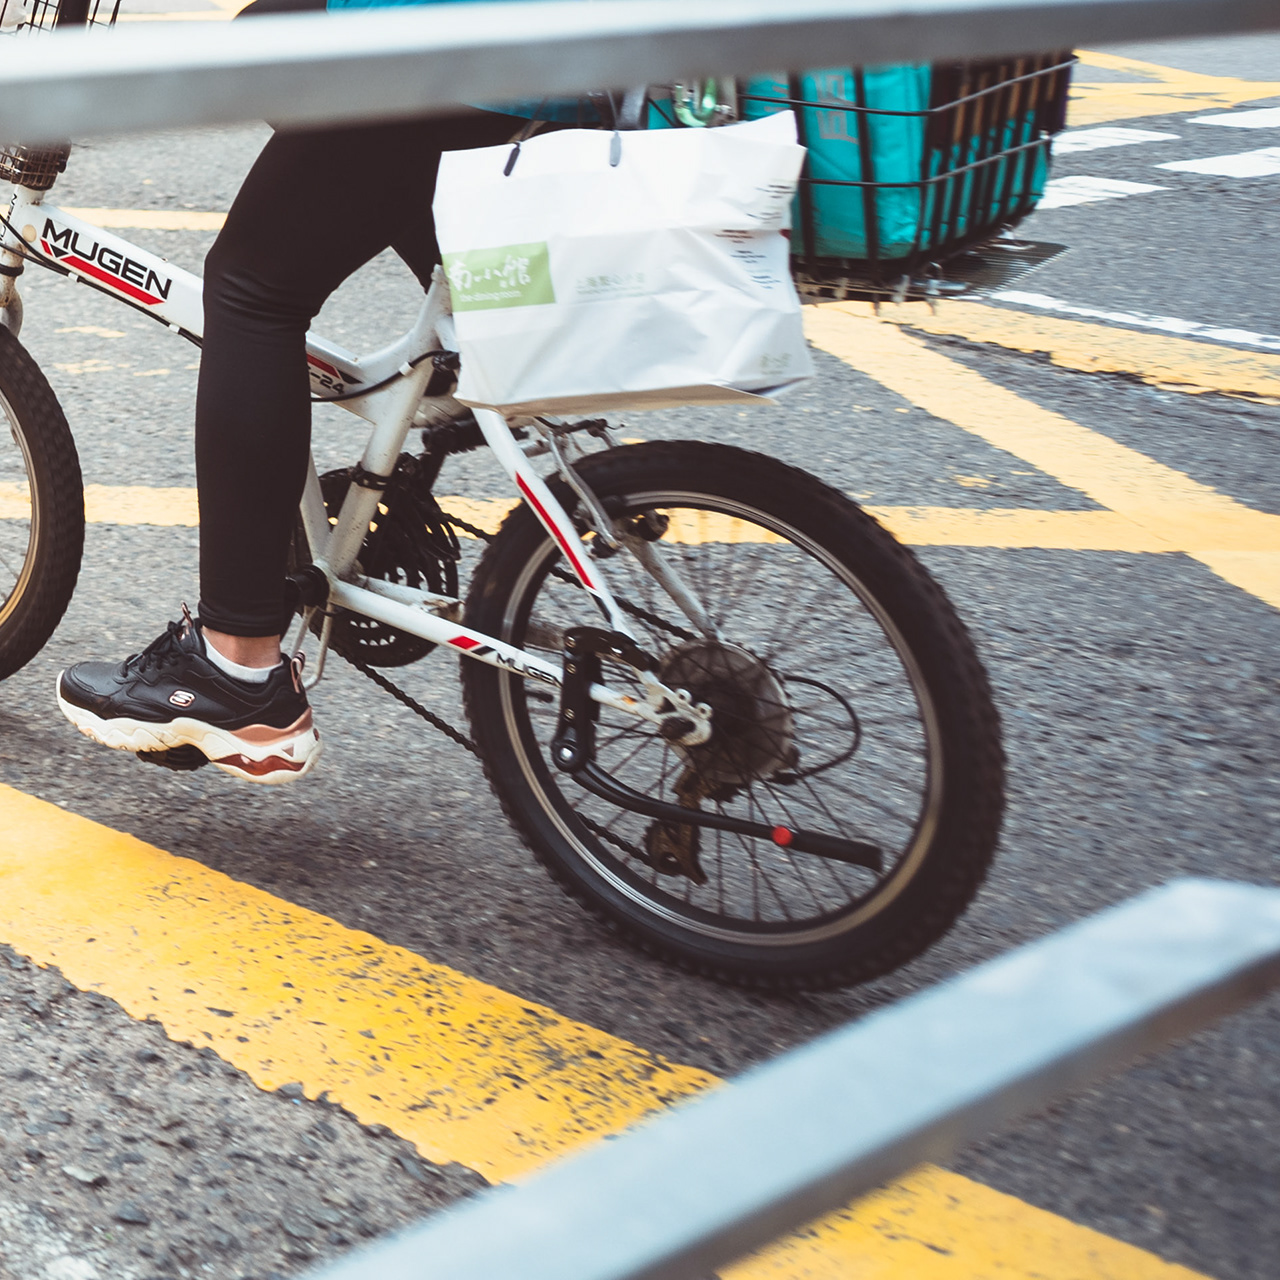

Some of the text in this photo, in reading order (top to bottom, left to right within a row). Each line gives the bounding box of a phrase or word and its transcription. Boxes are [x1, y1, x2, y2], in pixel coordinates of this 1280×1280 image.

[42, 218, 172, 300] MUGEN
[447, 254, 532, 292] 南小館
